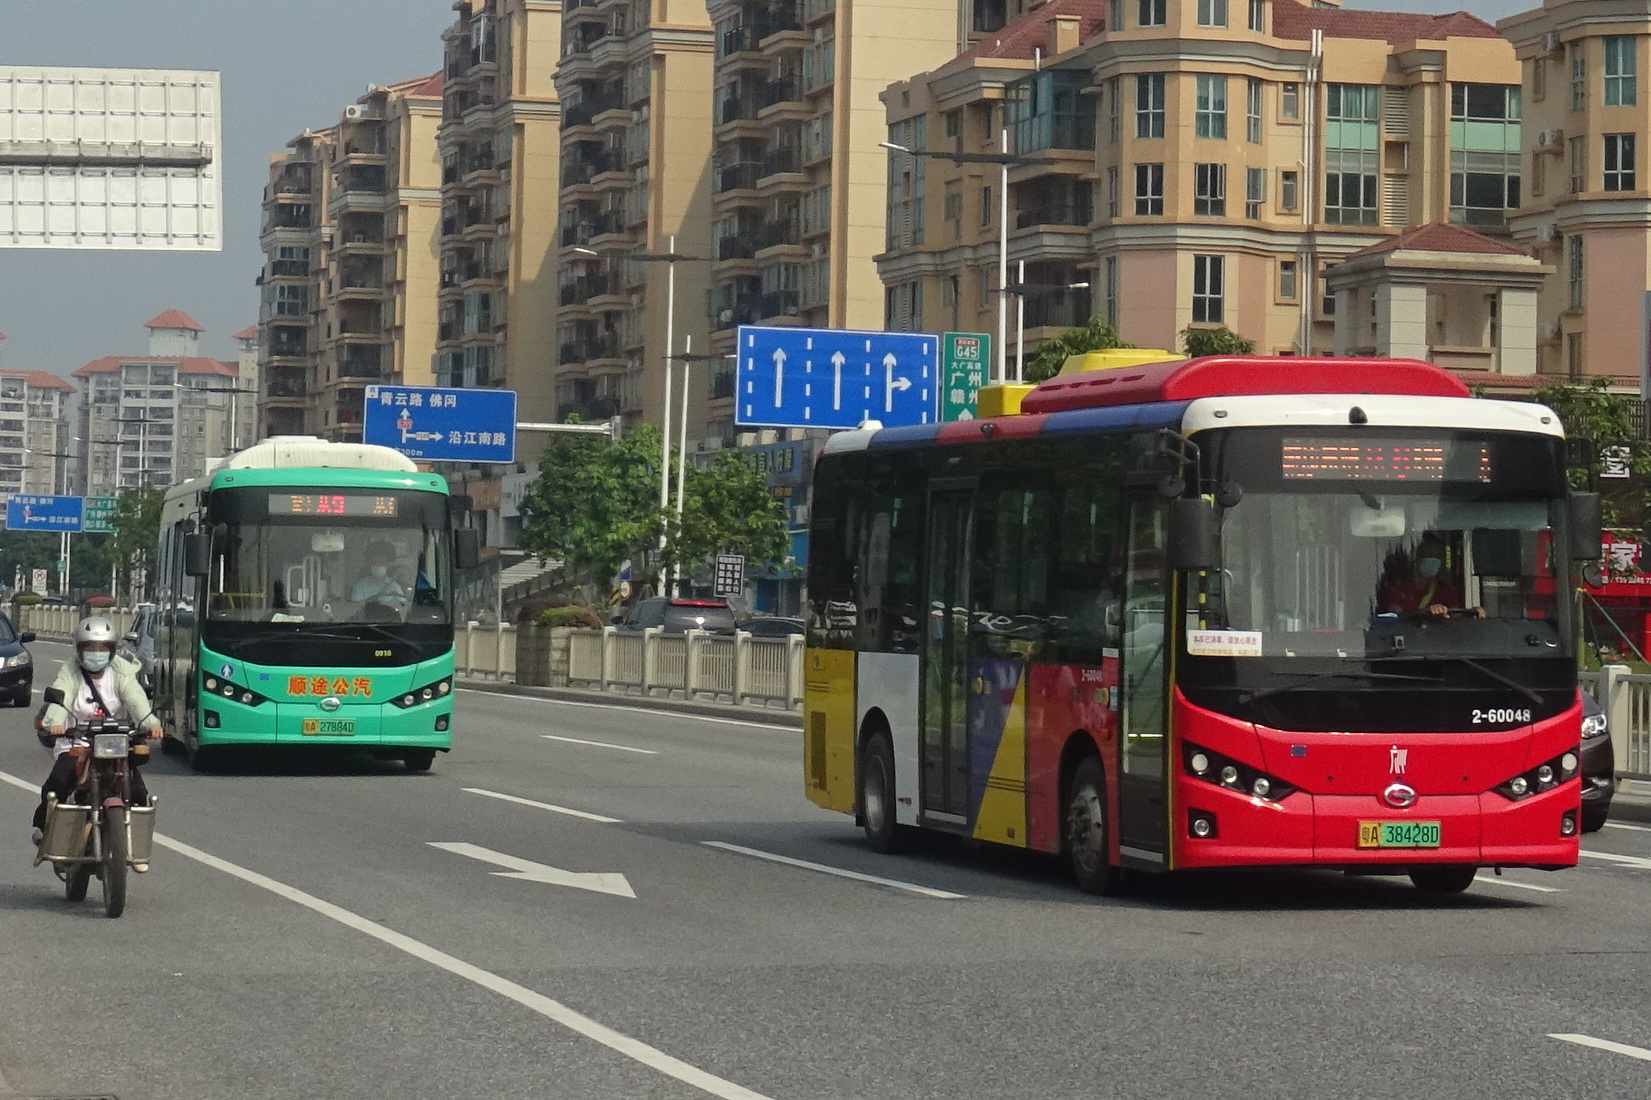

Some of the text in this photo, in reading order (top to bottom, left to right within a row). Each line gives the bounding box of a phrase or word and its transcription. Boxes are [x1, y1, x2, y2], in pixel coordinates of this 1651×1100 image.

[957, 346, 977, 358] G45
[950, 371, 982, 386] 广州
[380, 392, 457, 408] 青云路 佛冈
[448, 430, 507, 447] 沿江南路
[288, 675, 372, 697] 顺途公汽
[1472, 709, 1531, 724] 2-60048
